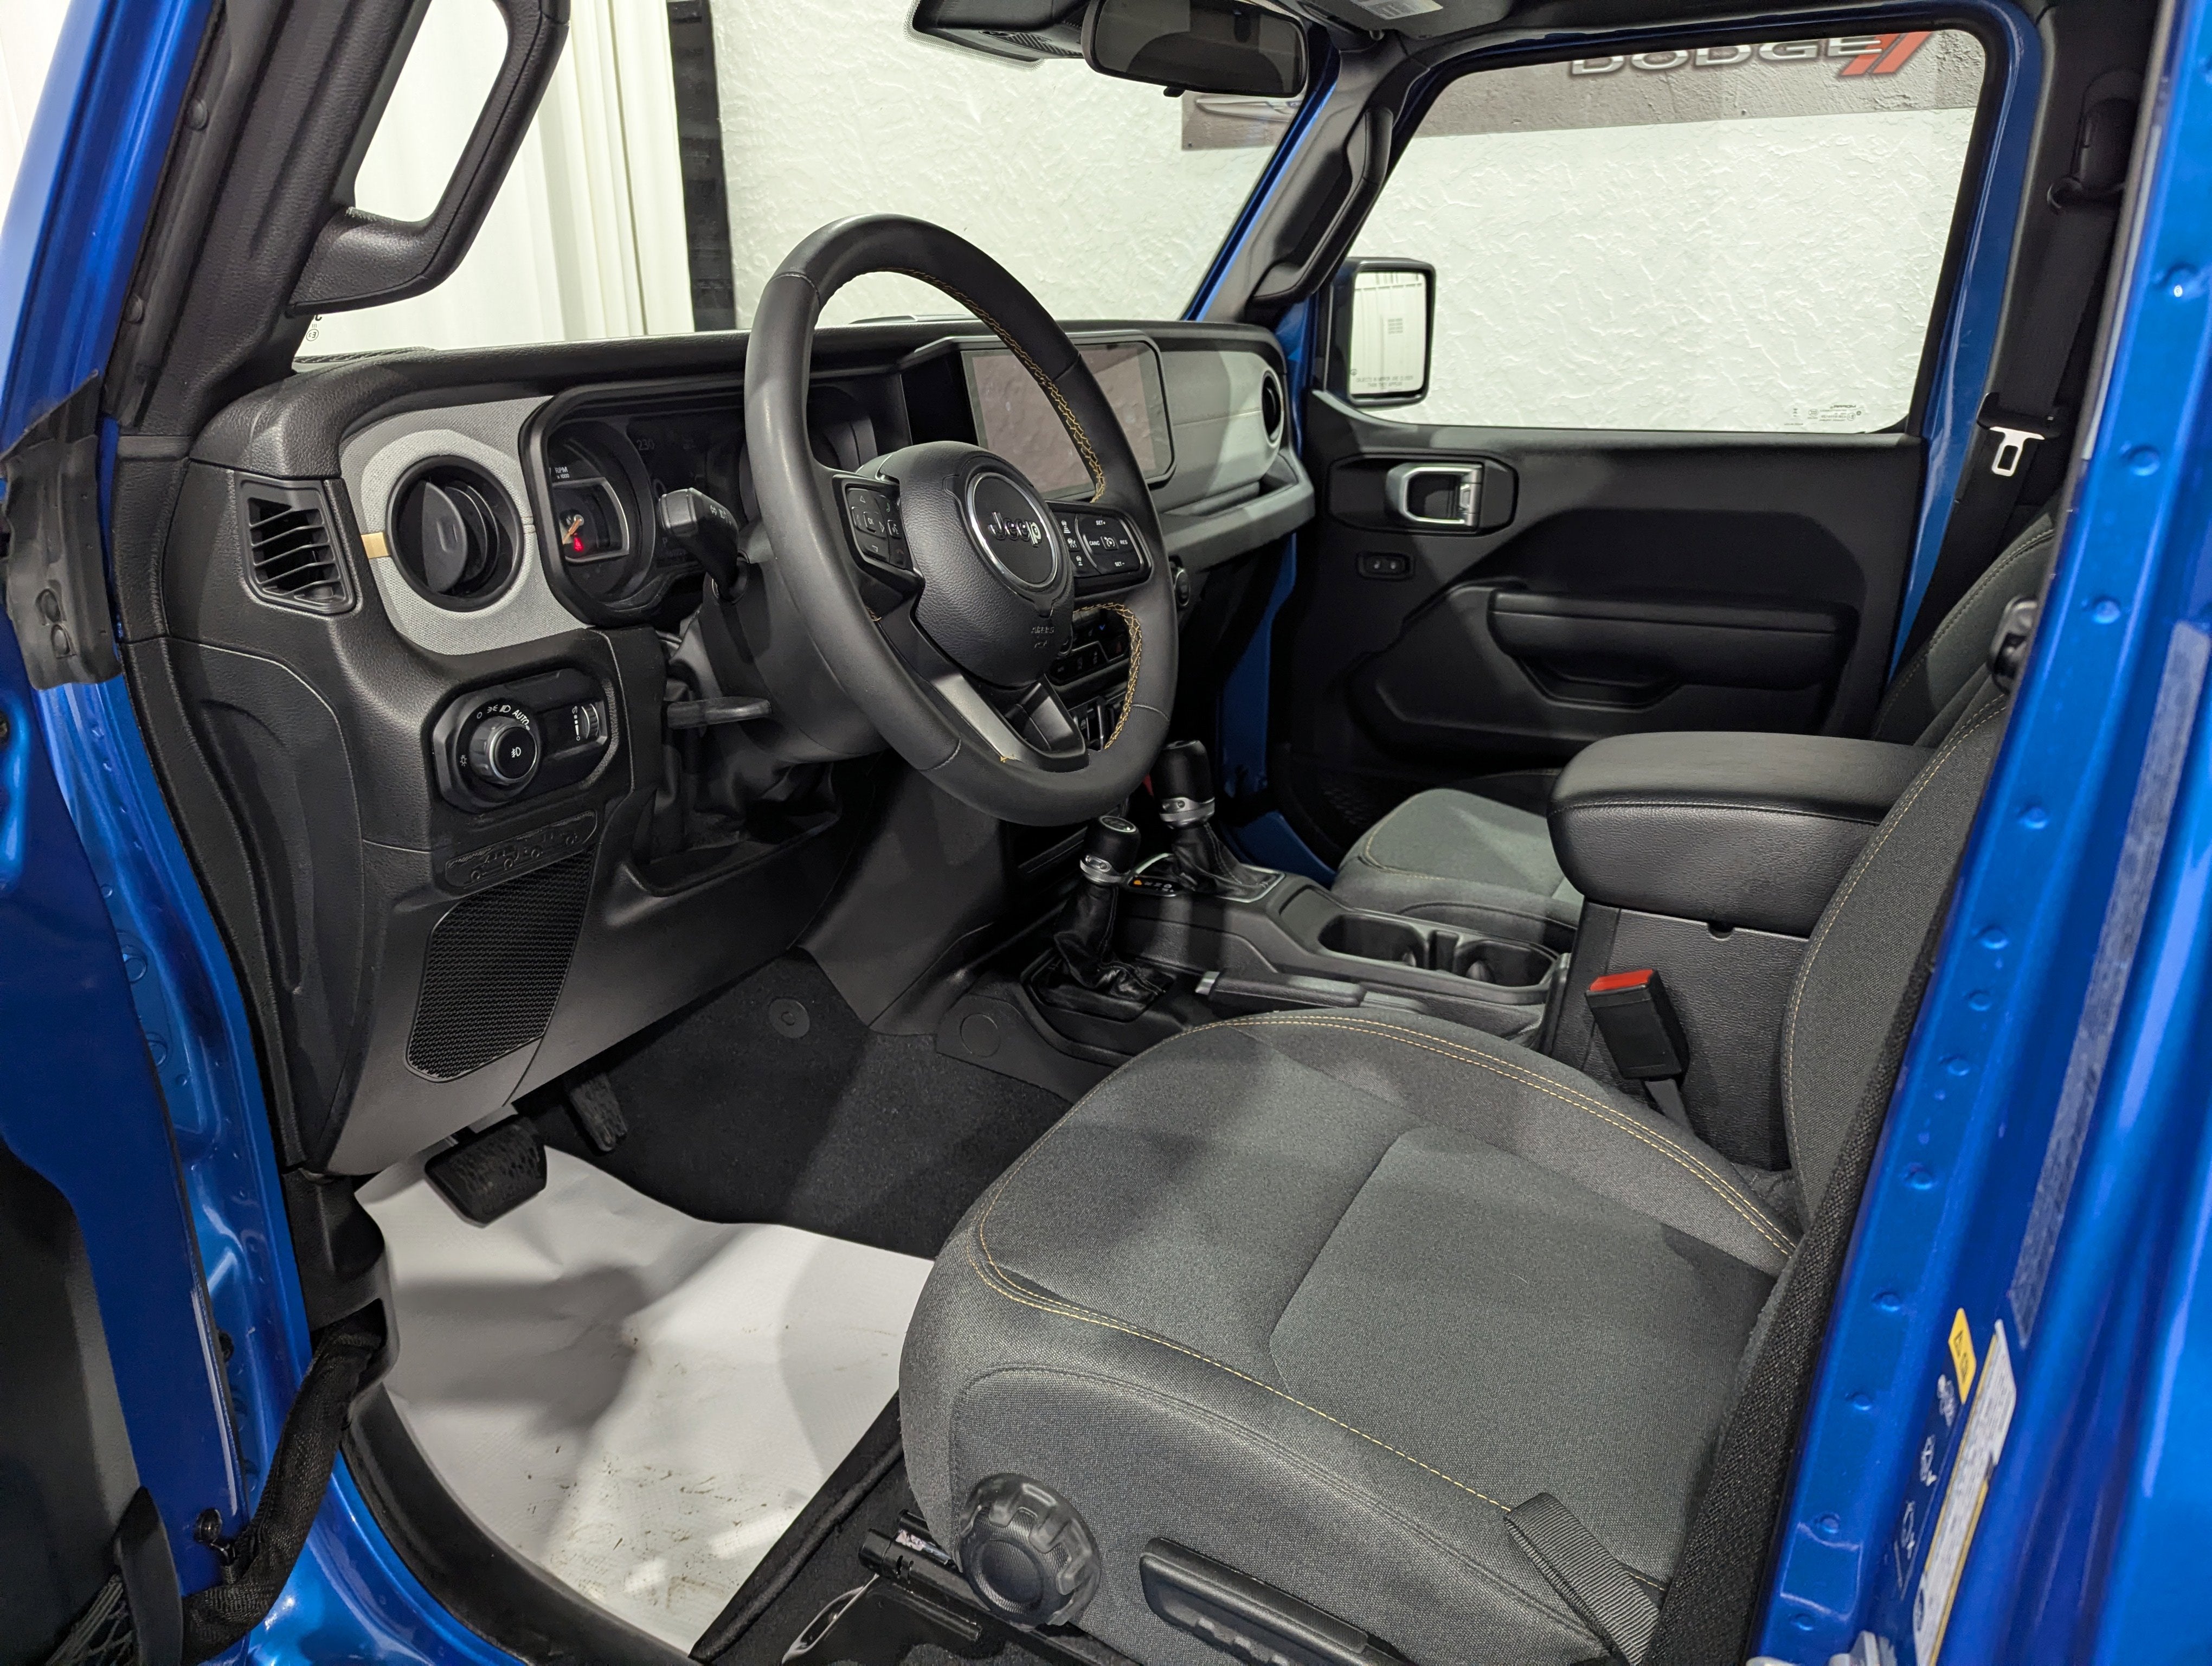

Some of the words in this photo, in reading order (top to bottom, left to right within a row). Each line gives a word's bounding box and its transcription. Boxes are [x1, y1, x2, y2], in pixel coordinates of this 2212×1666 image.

[1572, 39, 1882, 74] DODGE
[987, 511, 1041, 547] Jeep
[512, 709, 530, 725] AUTO
